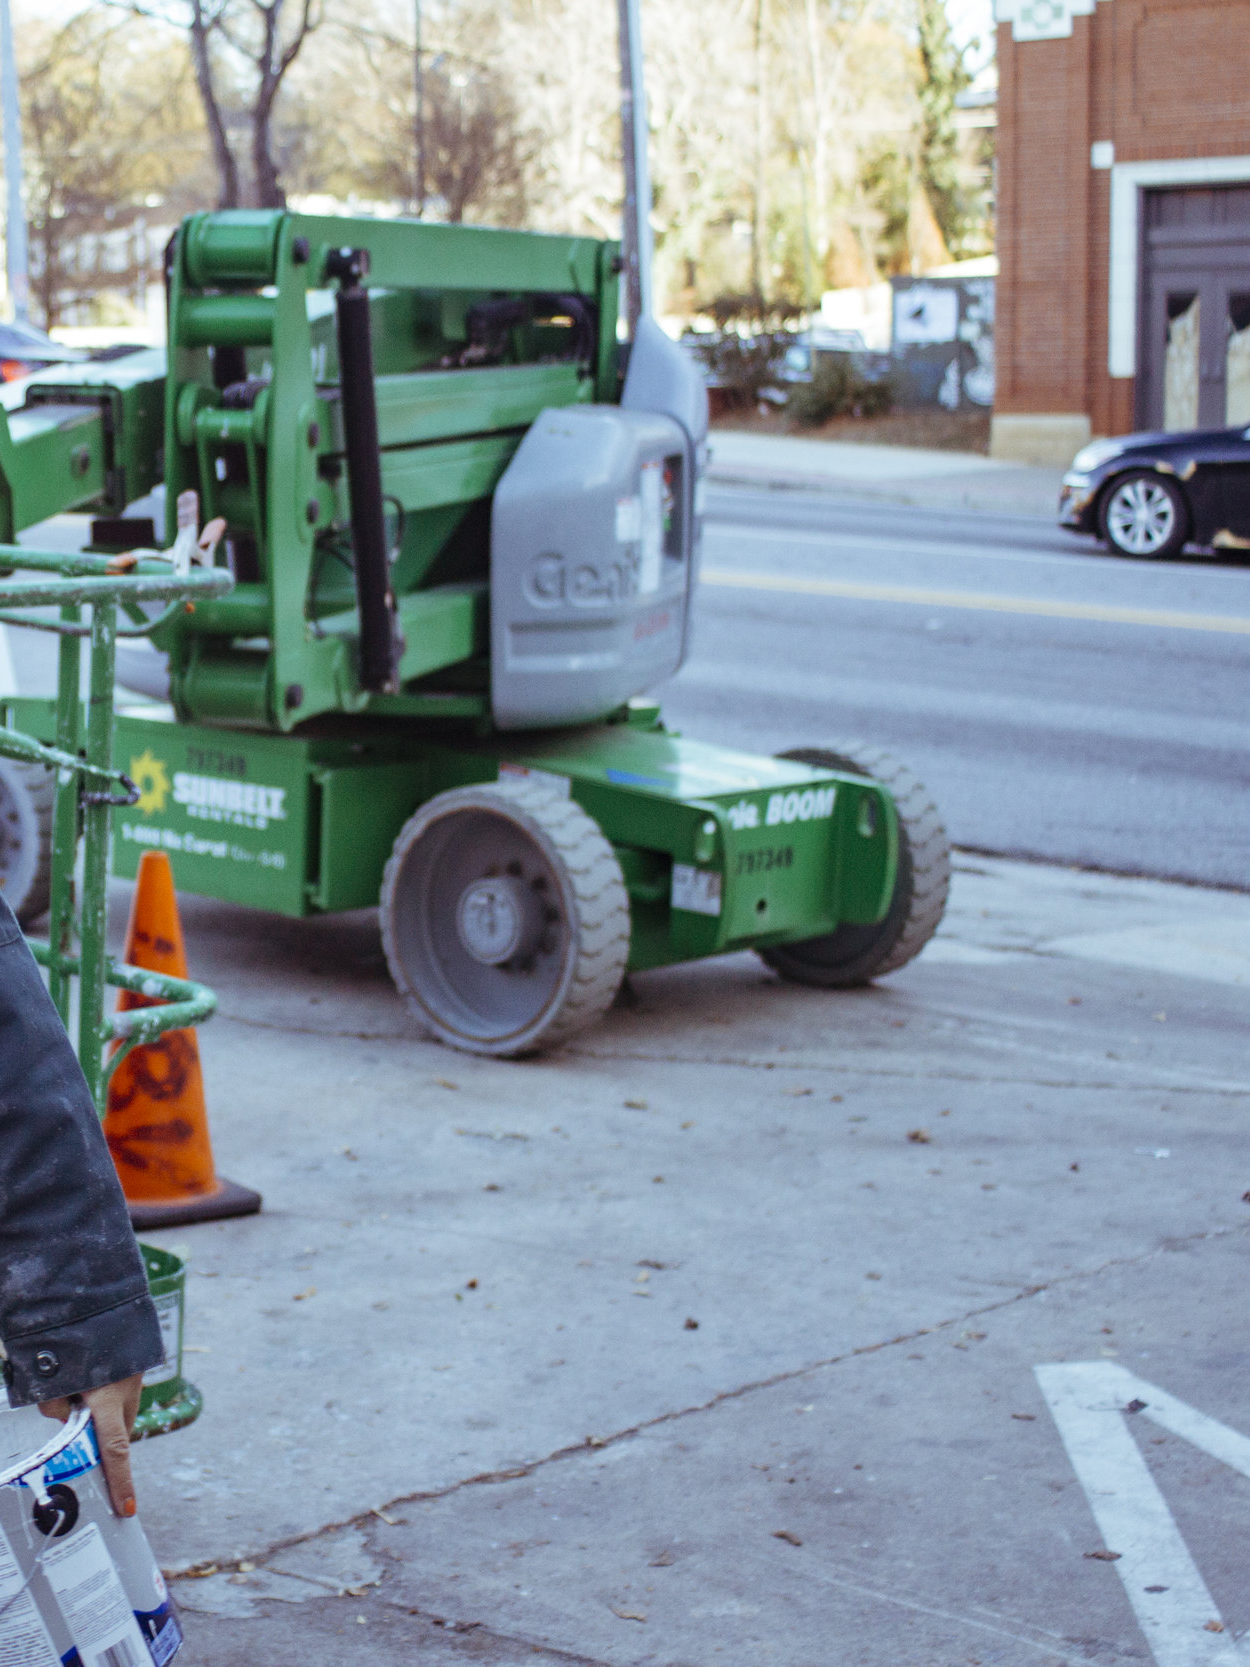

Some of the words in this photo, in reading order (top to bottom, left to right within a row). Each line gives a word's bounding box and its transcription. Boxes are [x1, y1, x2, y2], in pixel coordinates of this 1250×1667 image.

[174, 772, 285, 817] SUNBELT
[765, 788, 837, 826] BOOM
[188, 806, 268, 829] RENTALS
